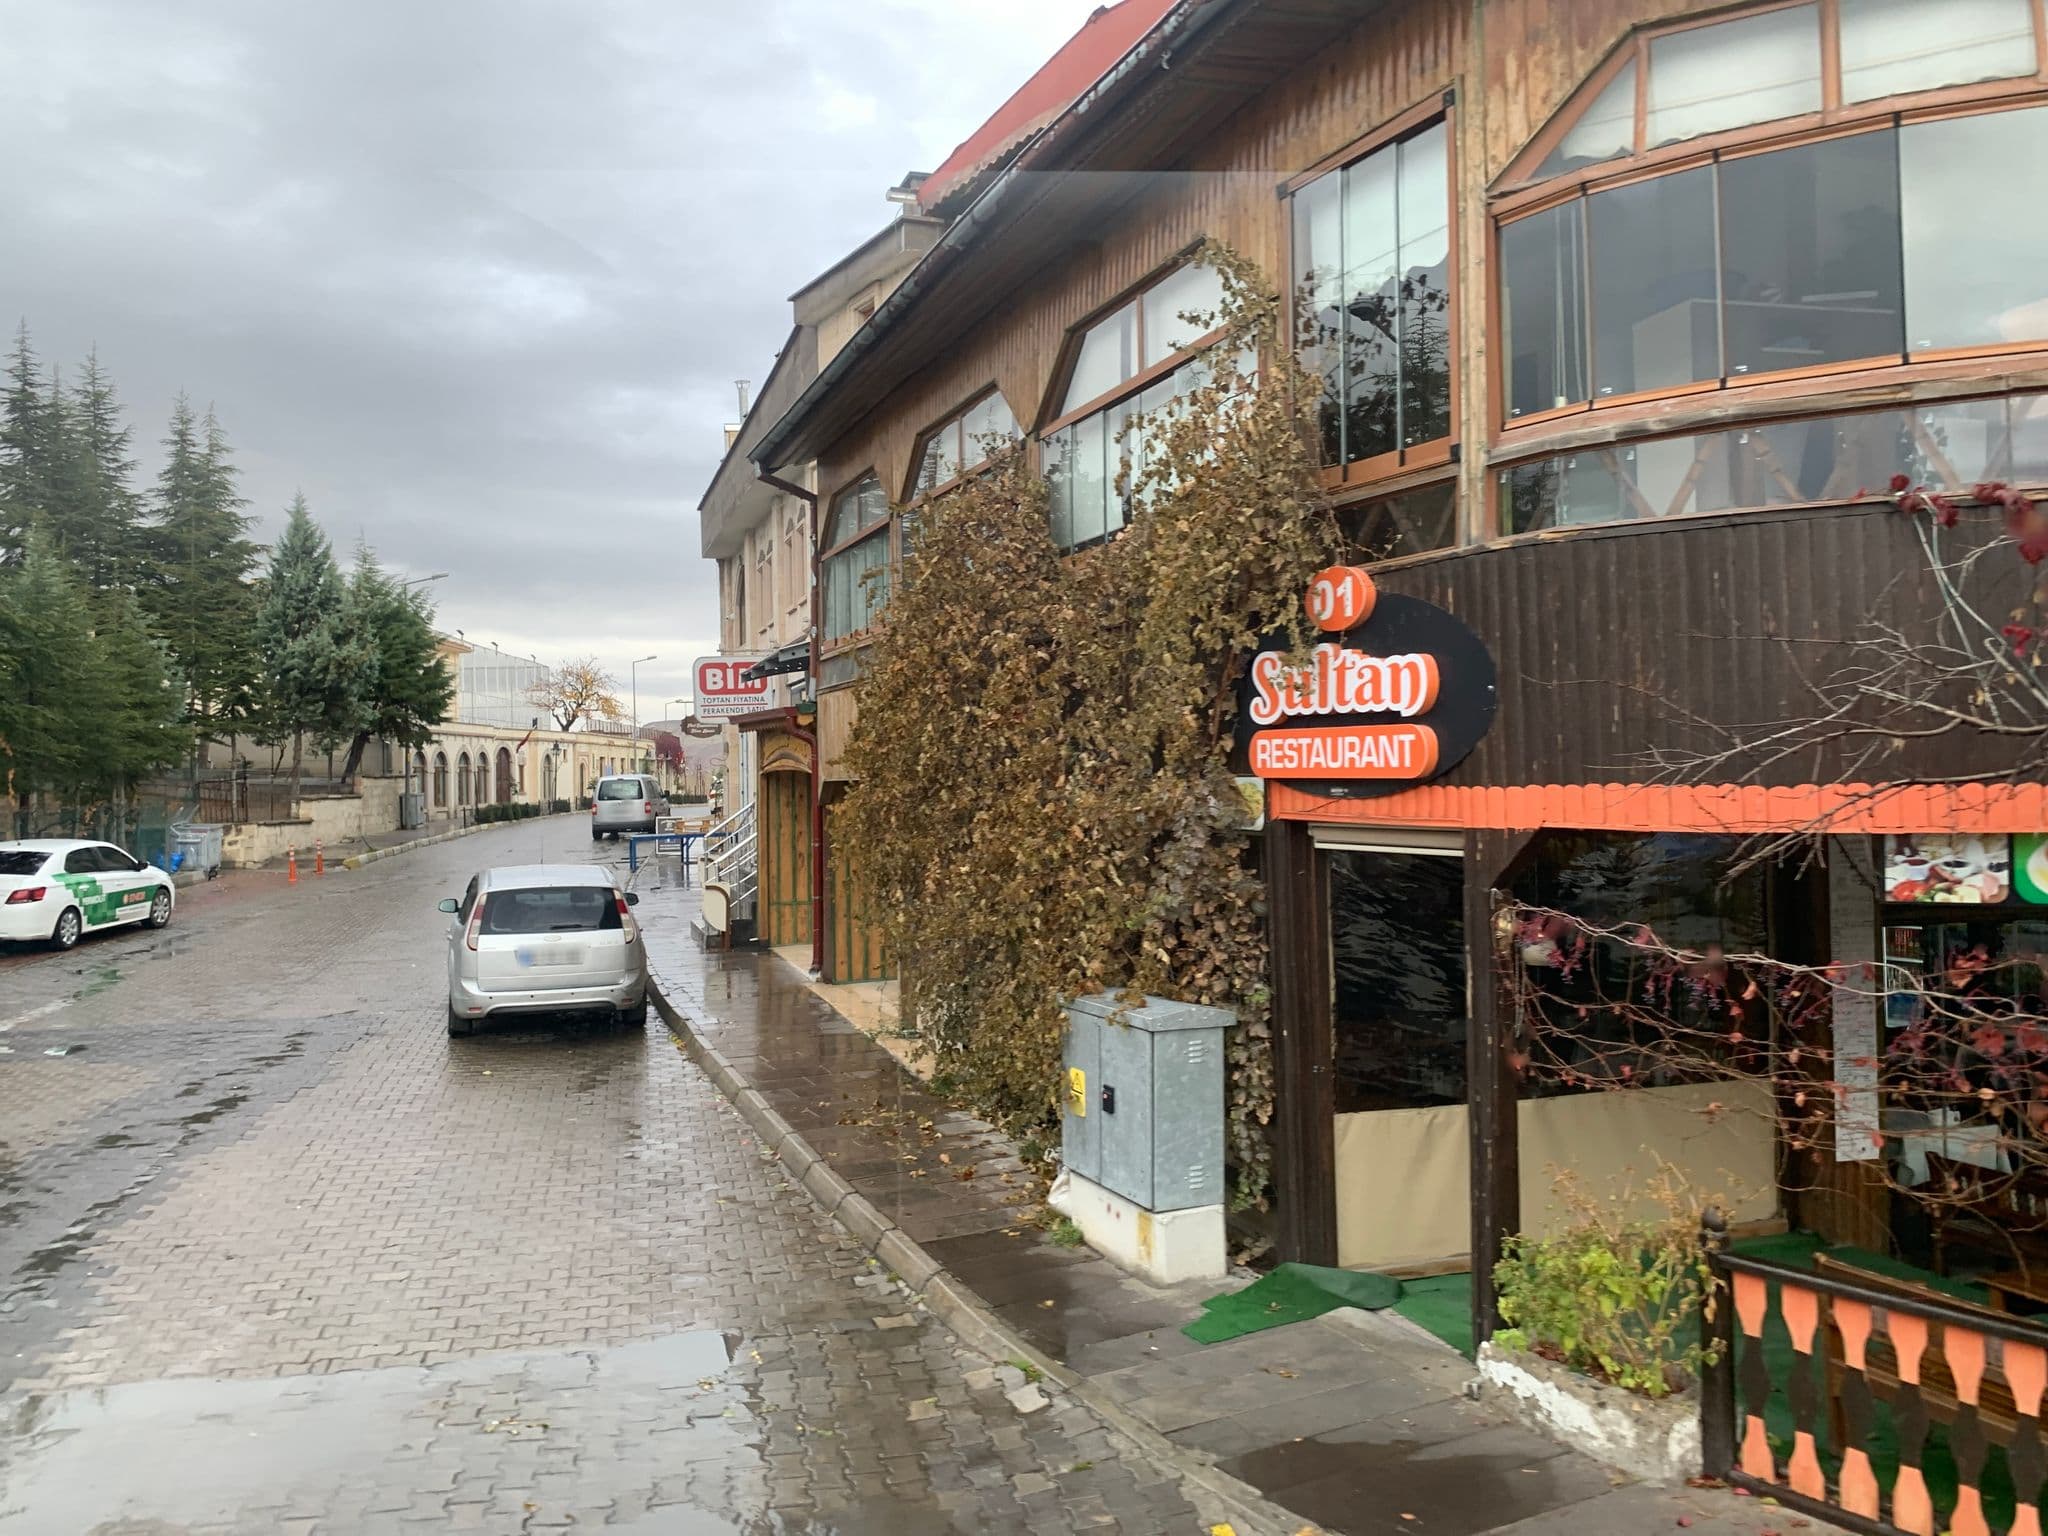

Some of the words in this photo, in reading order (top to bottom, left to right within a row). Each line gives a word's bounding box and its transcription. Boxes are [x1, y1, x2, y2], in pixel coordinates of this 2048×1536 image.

[1313, 576, 1354, 620] 01
[1250, 643, 1430, 725] Sultan
[1256, 734, 1416, 769] RESTAURANT
